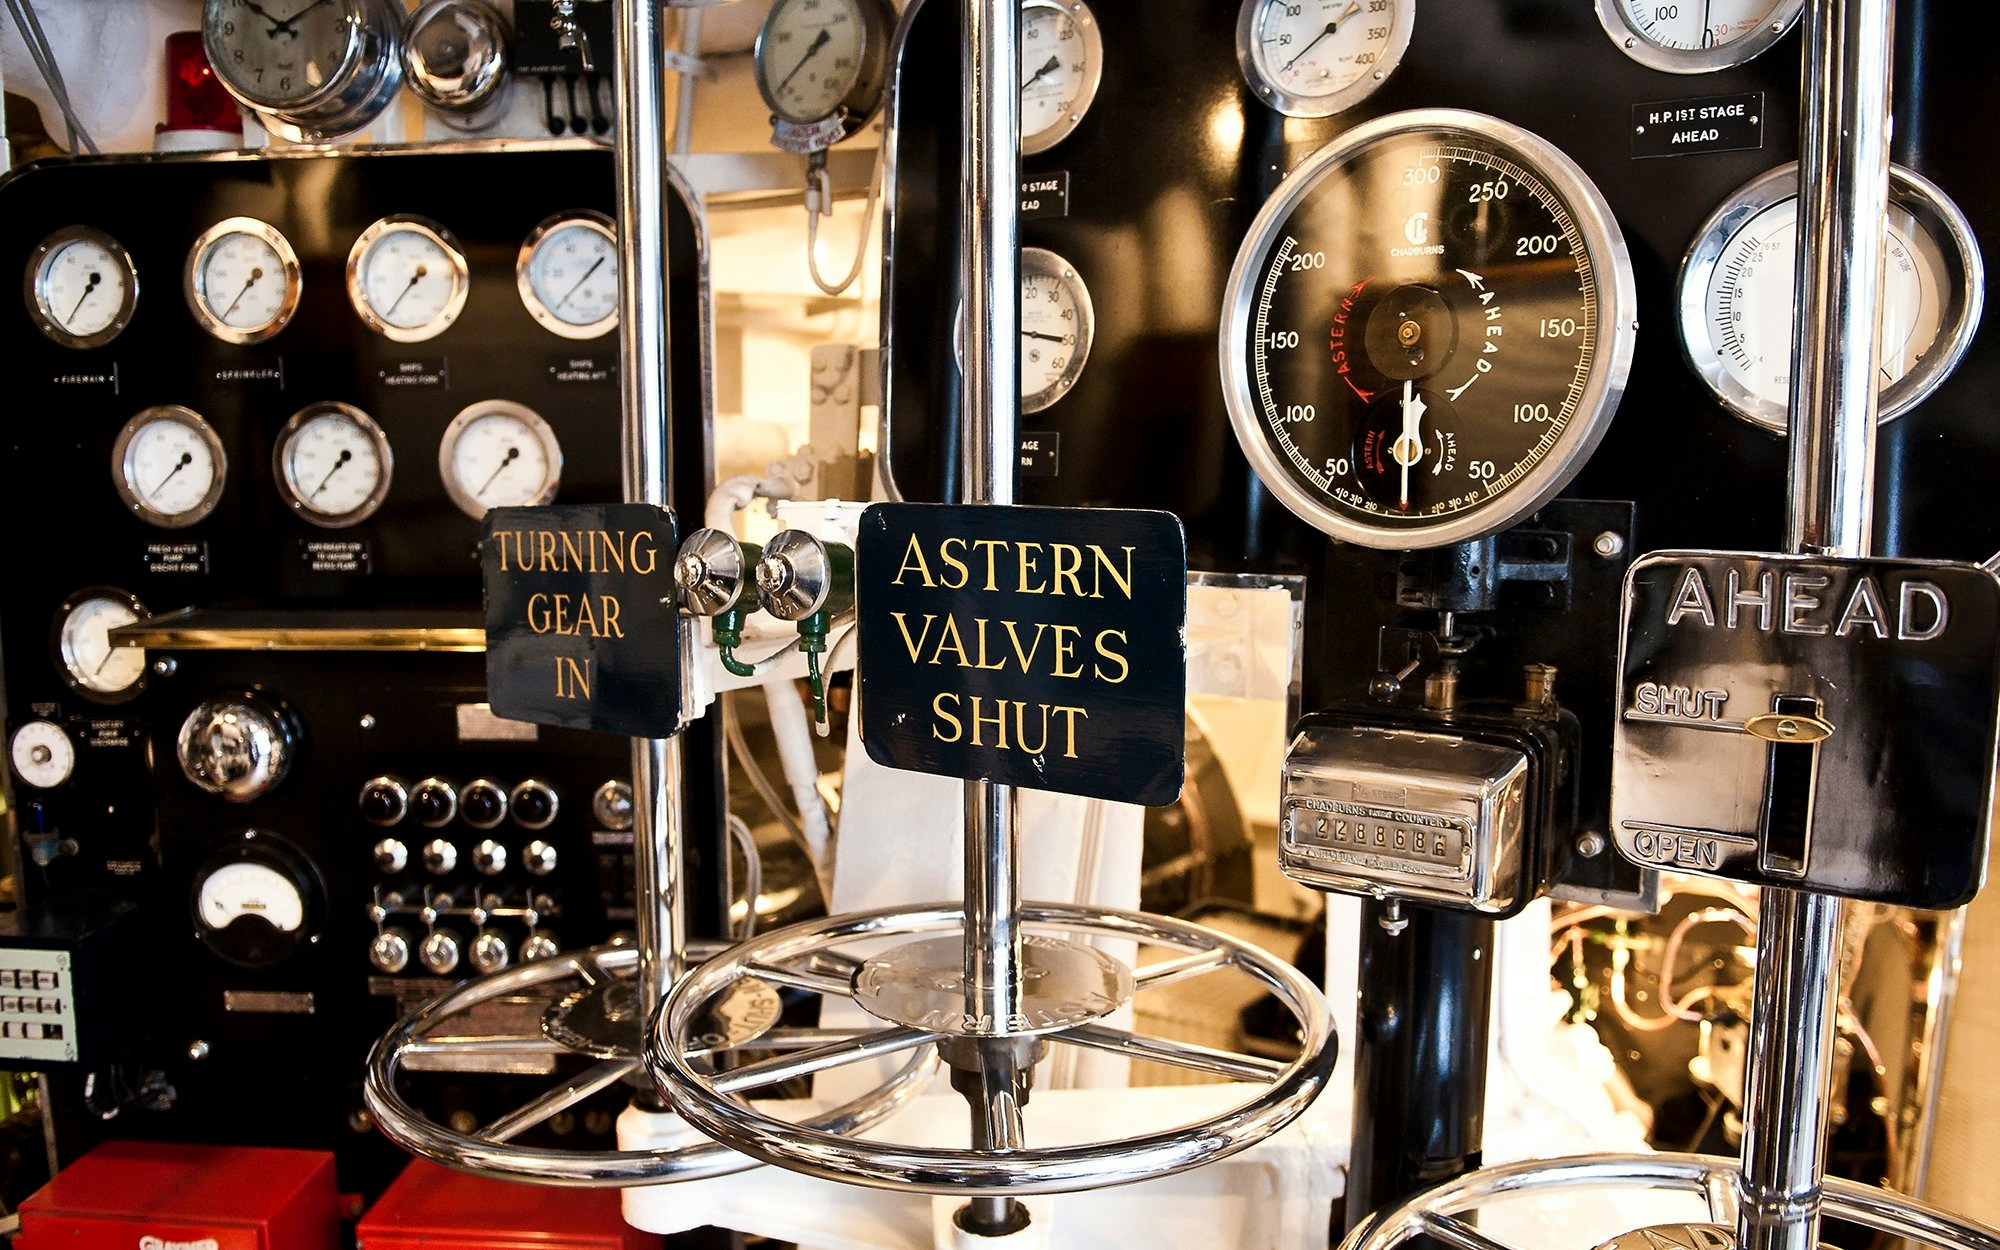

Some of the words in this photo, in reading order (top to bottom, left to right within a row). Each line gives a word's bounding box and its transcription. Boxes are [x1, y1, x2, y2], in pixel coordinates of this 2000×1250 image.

[1286, 5, 1300, 17] 100
[1368, 0, 1387, 13] 300
[1655, 5, 1678, 21] 100
[224, 21, 235, 36] 9
[1368, 27, 1387, 40] 350
[1714, 24, 1728, 36] 30
[1279, 34, 1292, 46] 50
[234, 50, 244, 63] 8
[1355, 53, 1376, 65] 400
[254, 68, 264, 82] 7
[280, 77, 291, 91] 6
[1700, 104, 1744, 119] STAGE
[1672, 128, 1719, 144] AHEAD
[1402, 165, 1441, 187] 300
[1030, 180, 1058, 192] STAGE
[1468, 181, 1509, 204] 250
[1021, 200, 1040, 210] EAD
[1390, 245, 1445, 257] CHADBURNS
[1516, 235, 1558, 258] 200
[1892, 248, 1904, 258] DIP
[1291, 252, 1326, 272] 200
[1752, 252, 1764, 262] 25
[1742, 268, 1753, 278] 20
[1025, 287, 1038, 299] 20
[1048, 291, 1060, 303] 30
[1734, 288, 1743, 299] 15
[1060, 308, 1073, 320] 40
[1732, 312, 1742, 322] 10
[1476, 291, 1503, 374] AHEAD
[1540, 318, 1576, 338] 150
[1062, 334, 1076, 346] 50
[1270, 332, 1300, 350] 150
[1330, 297, 1354, 375] ASTERN
[1740, 334, 1745, 343] 5
[1052, 357, 1064, 368] 60
[61, 375, 106, 384] FIREMAIN
[1286, 405, 1316, 423] 100
[1514, 404, 1549, 424] 100
[1021, 440, 1039, 450] AGE
[1444, 432, 1457, 472] AHEAD
[1325, 458, 1349, 476] 50
[1468, 461, 1496, 479] 50
[492, 531, 657, 575] TURNING
[891, 532, 1137, 600] ASTERN
[1667, 566, 1950, 642] AHEAD
[527, 593, 625, 640] GEAR
[890, 612, 1130, 684] VALVES
[555, 656, 592, 700] IN
[1637, 682, 1729, 722] SHUT
[932, 692, 1090, 759] SHUT
[1305, 800, 1366, 816] CHADBURNS
[1394, 812, 1447, 828] COUNTER
[1634, 830, 1718, 867] OPEN
